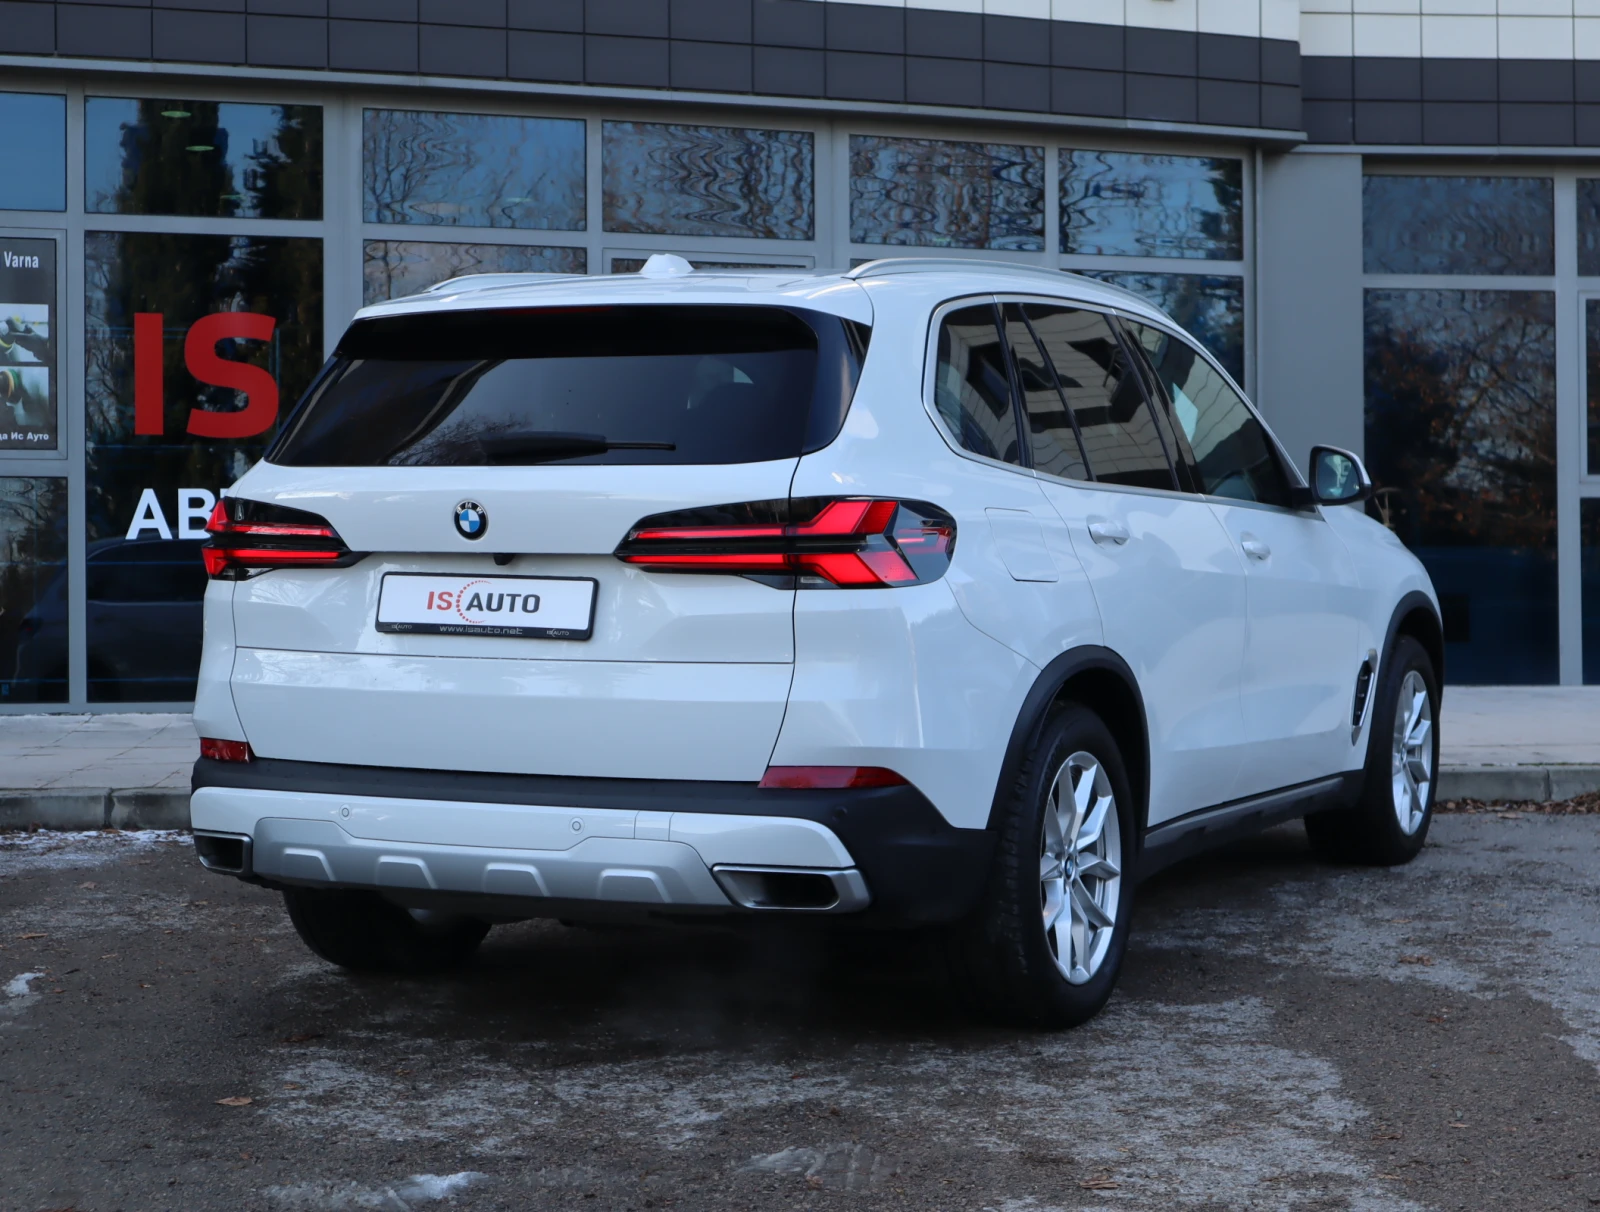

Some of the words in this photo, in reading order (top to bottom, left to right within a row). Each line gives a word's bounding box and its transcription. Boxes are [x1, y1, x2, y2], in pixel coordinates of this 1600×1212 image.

[4, 251, 39, 268] Varna
[134, 311, 280, 439] IS
[11, 432, 24, 440] Ис
[27, 432, 49, 442] Ауто
[456, 502, 484, 515] BMW
[427, 591, 454, 611] IS
[465, 592, 541, 614] AUTO
[439, 625, 523, 635] www.isauto.net
